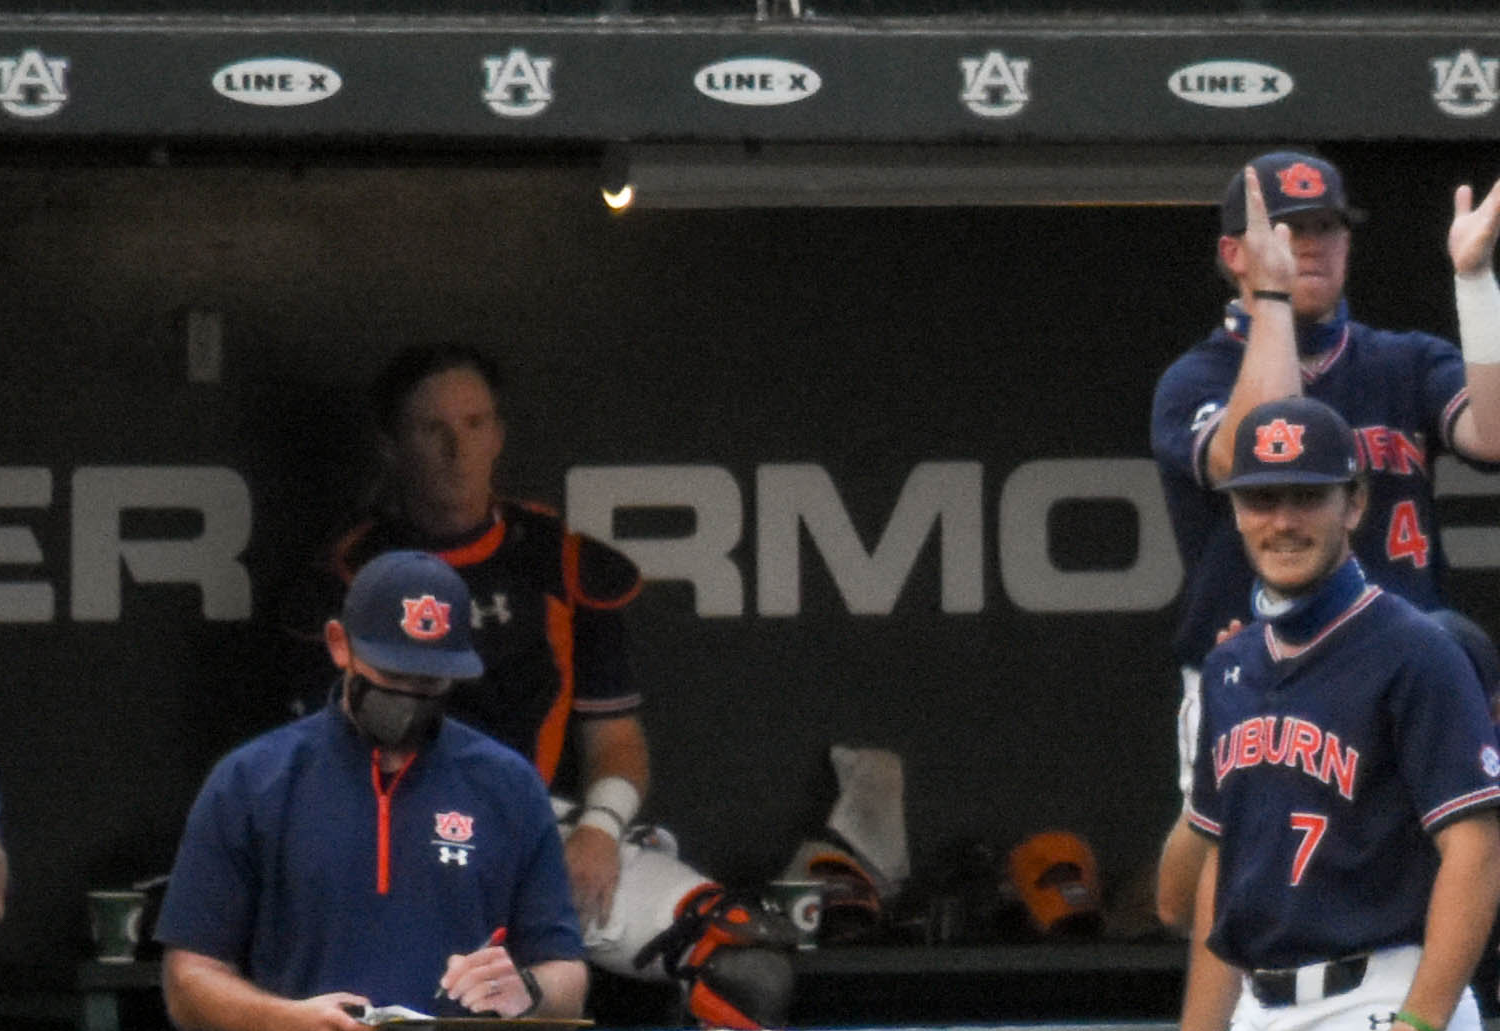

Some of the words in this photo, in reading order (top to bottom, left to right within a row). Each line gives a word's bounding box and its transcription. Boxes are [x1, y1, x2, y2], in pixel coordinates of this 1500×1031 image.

[1386, 500, 1430, 569] 4
[1211, 716, 1359, 800] UBURN
[1290, 812, 1328, 887] 7
